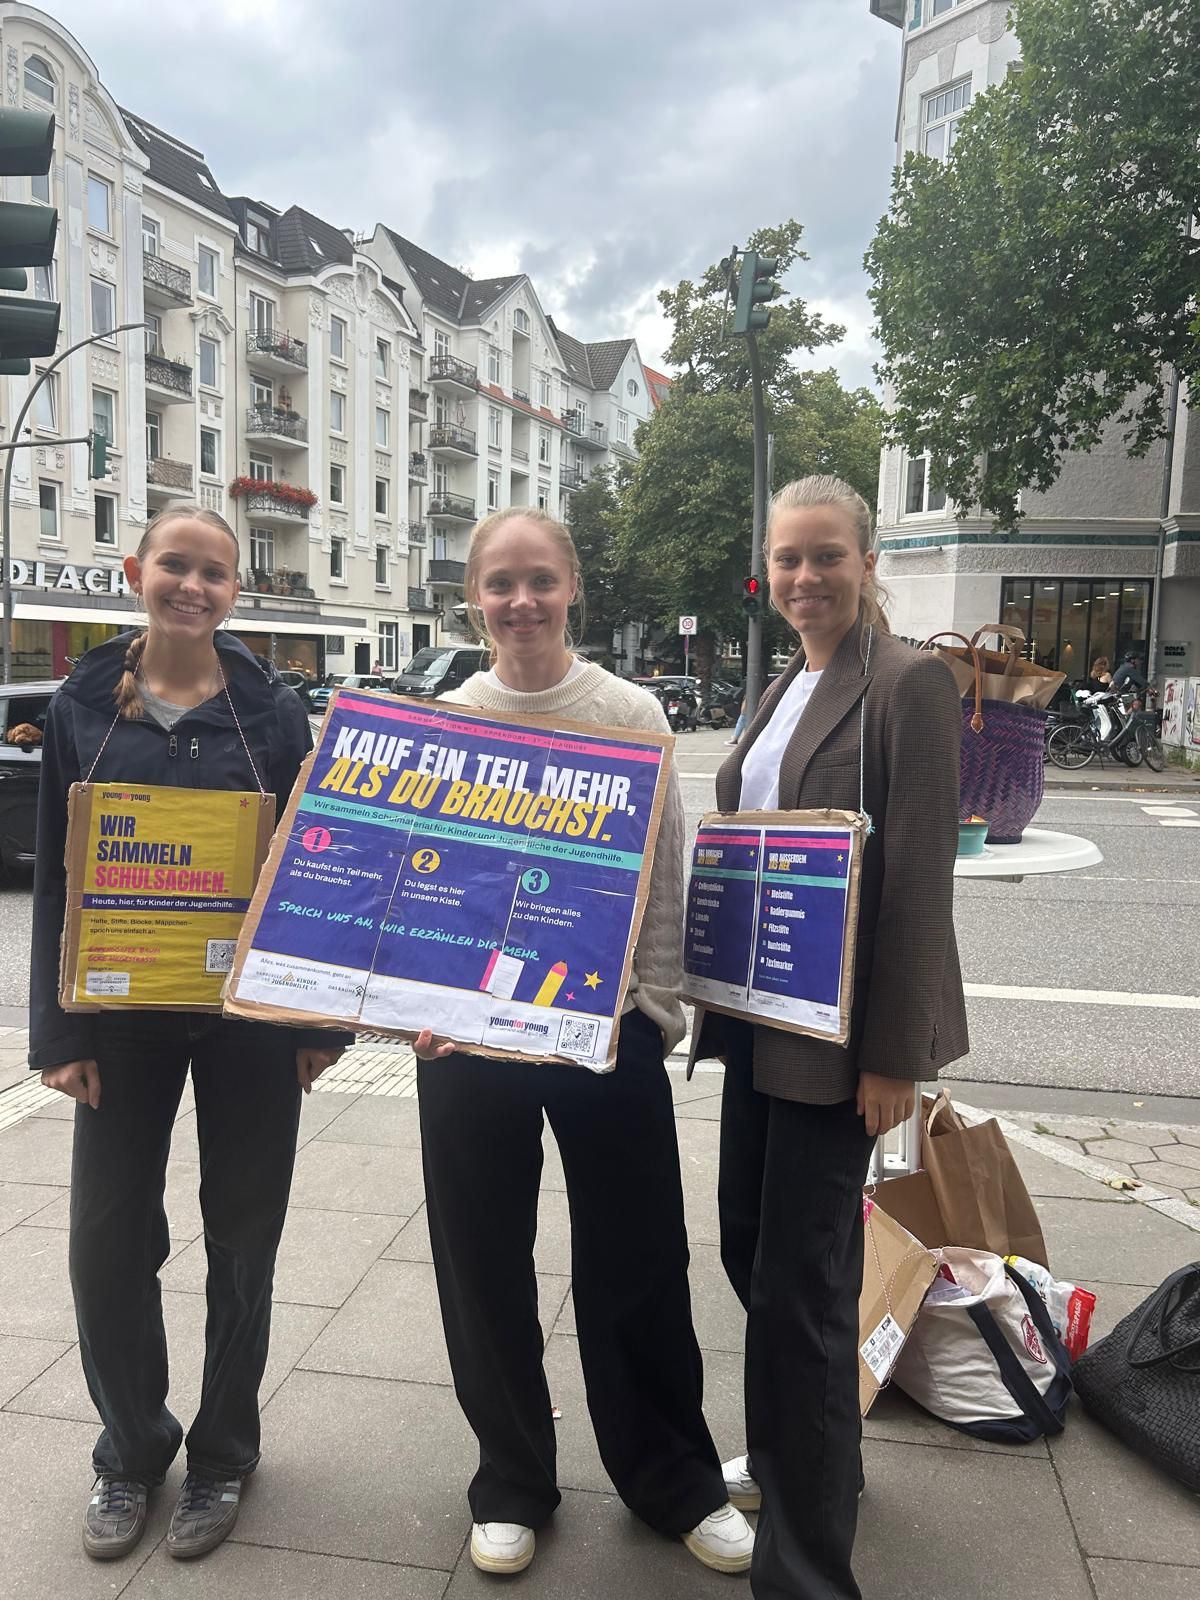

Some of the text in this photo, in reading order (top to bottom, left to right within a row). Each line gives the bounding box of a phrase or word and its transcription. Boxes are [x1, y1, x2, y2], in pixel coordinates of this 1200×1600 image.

[332, 726, 636, 816] KAUF EIN TEIL MEHR,
[318, 757, 614, 841] ALS DU BRAUCHST.
[100, 814, 136, 837] WIR
[314, 800, 624, 863] Wir sammeln Schulmaterial für Kinder und Jugendliche der Jugendhilfe.
[312, 829, 323, 850] 1
[96, 840, 192, 866] SAMMELN
[418, 850, 433, 872] 2
[95, 864, 229, 893] SCHULSACHEN.
[290, 868, 352, 887] als du brauchst.
[294, 858, 383, 881] Du kaufst ein Teil mehr,
[404, 879, 416, 888] Du
[417, 880, 437, 892] legst
[449, 886, 465, 896] hier
[528, 871, 543, 892] 3
[92, 897, 117, 906] Heute,
[118, 898, 135, 906] hier,
[148, 899, 174, 907] Kinder
[188, 900, 236, 908] Jugendhilfe.
[401, 889, 462, 907] in unsere Kiste.
[515, 900, 581, 918] Wir bringen alles
[512, 912, 574, 928] zu den Kindern.
[278, 901, 540, 961] SPRICH UNS AN, WIR ERZÄHLEN DIR MEHR
[271, 979, 309, 991] JUGENDHILFE
[489, 1016, 549, 1034] youngforyoung
